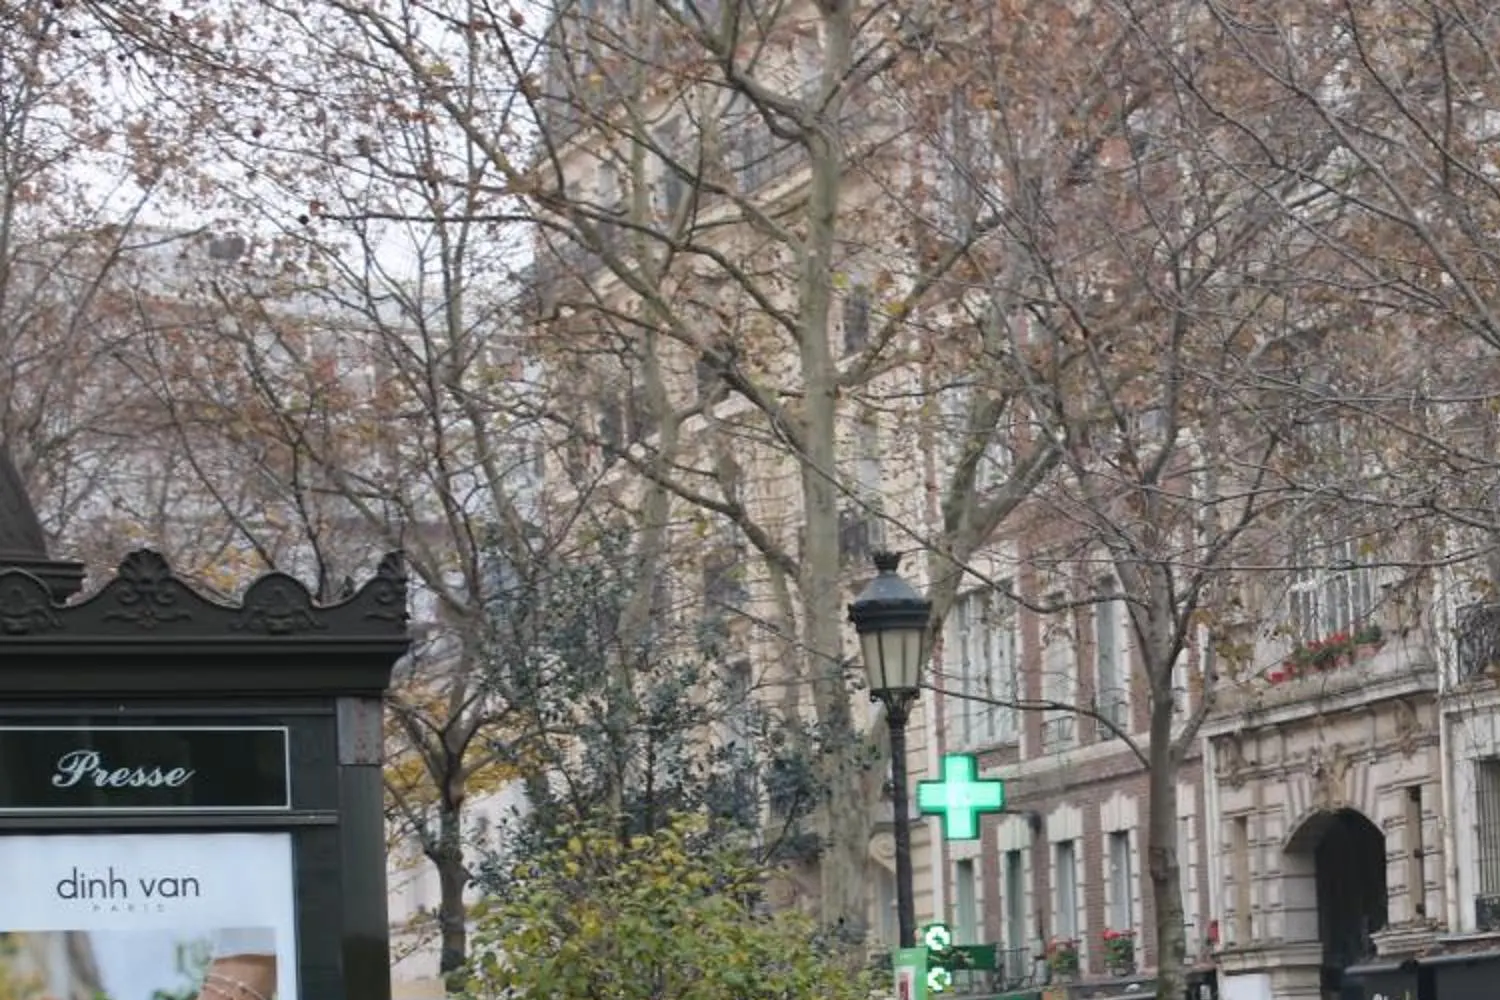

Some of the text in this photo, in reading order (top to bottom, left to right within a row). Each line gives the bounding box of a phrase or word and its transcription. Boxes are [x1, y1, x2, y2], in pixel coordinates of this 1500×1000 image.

[52, 749, 196, 788] Presse
[56, 866, 200, 899] dinh van
